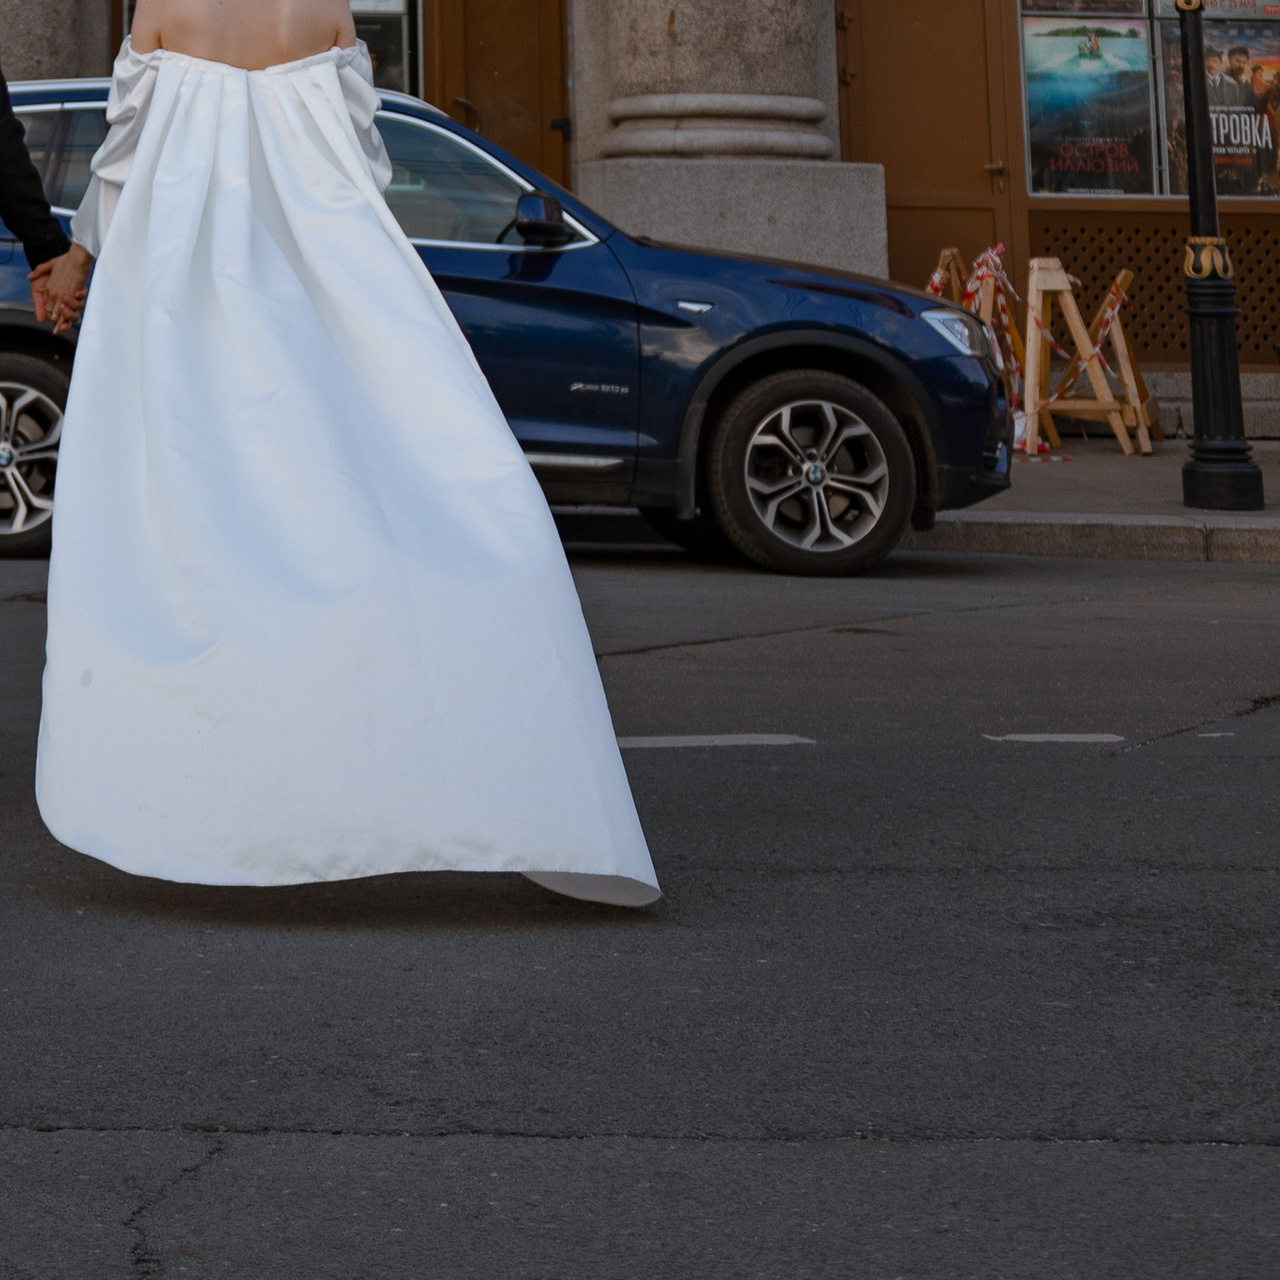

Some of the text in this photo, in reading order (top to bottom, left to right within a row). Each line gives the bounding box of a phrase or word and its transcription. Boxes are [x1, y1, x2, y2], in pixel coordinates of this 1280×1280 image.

[1210, 113, 1273, 150] ТРОВКА
[1060, 142, 1128, 158] ОСТРОВ
[1050, 157, 1139, 173] ИЛЛЮЗИЙ
